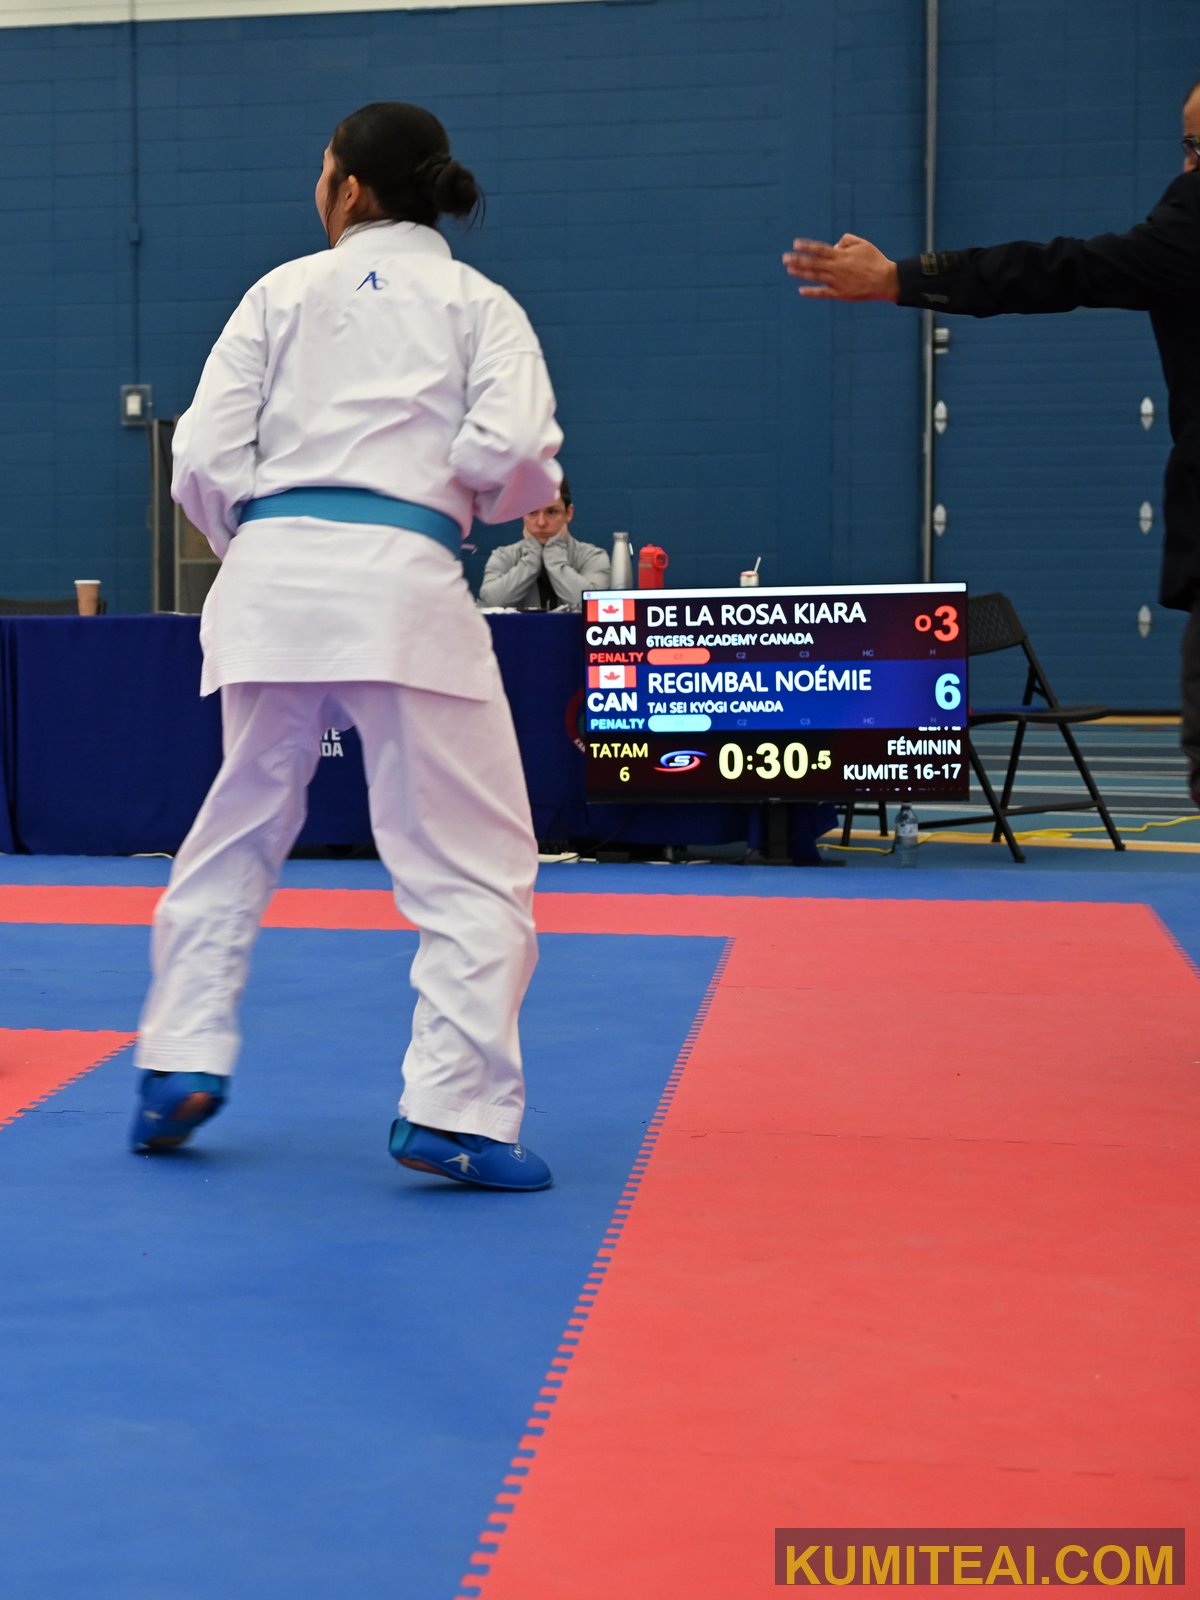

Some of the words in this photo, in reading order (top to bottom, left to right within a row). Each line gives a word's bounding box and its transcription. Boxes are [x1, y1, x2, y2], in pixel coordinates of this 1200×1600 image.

[647, 605, 678, 628] DE
[685, 604, 714, 627] LA
[721, 603, 787, 626] ROSA
[794, 601, 867, 624] KIARA
[586, 625, 637, 646] CAN
[646, 634, 695, 648] 6TIGERS
[696, 633, 757, 647] ACADEMY
[759, 632, 814, 645] CANADA
[589, 651, 644, 664] PENALTY
[648, 671, 769, 694] REGIMBAL
[775, 664, 872, 692] NOÉMIE
[934, 673, 961, 711] 6
[587, 692, 638, 713] CAN
[647, 702, 666, 714] TAI
[669, 702, 687, 714] SEI
[729, 700, 784, 713] CANADA
[590, 718, 645, 730] PENALTY
[589, 742, 649, 759] TATAM
[887, 735, 962, 756] FÉMININ
[619, 766, 631, 782] 6
[843, 764, 909, 780] KUMITE
[913, 763, 962, 780] 16-17
